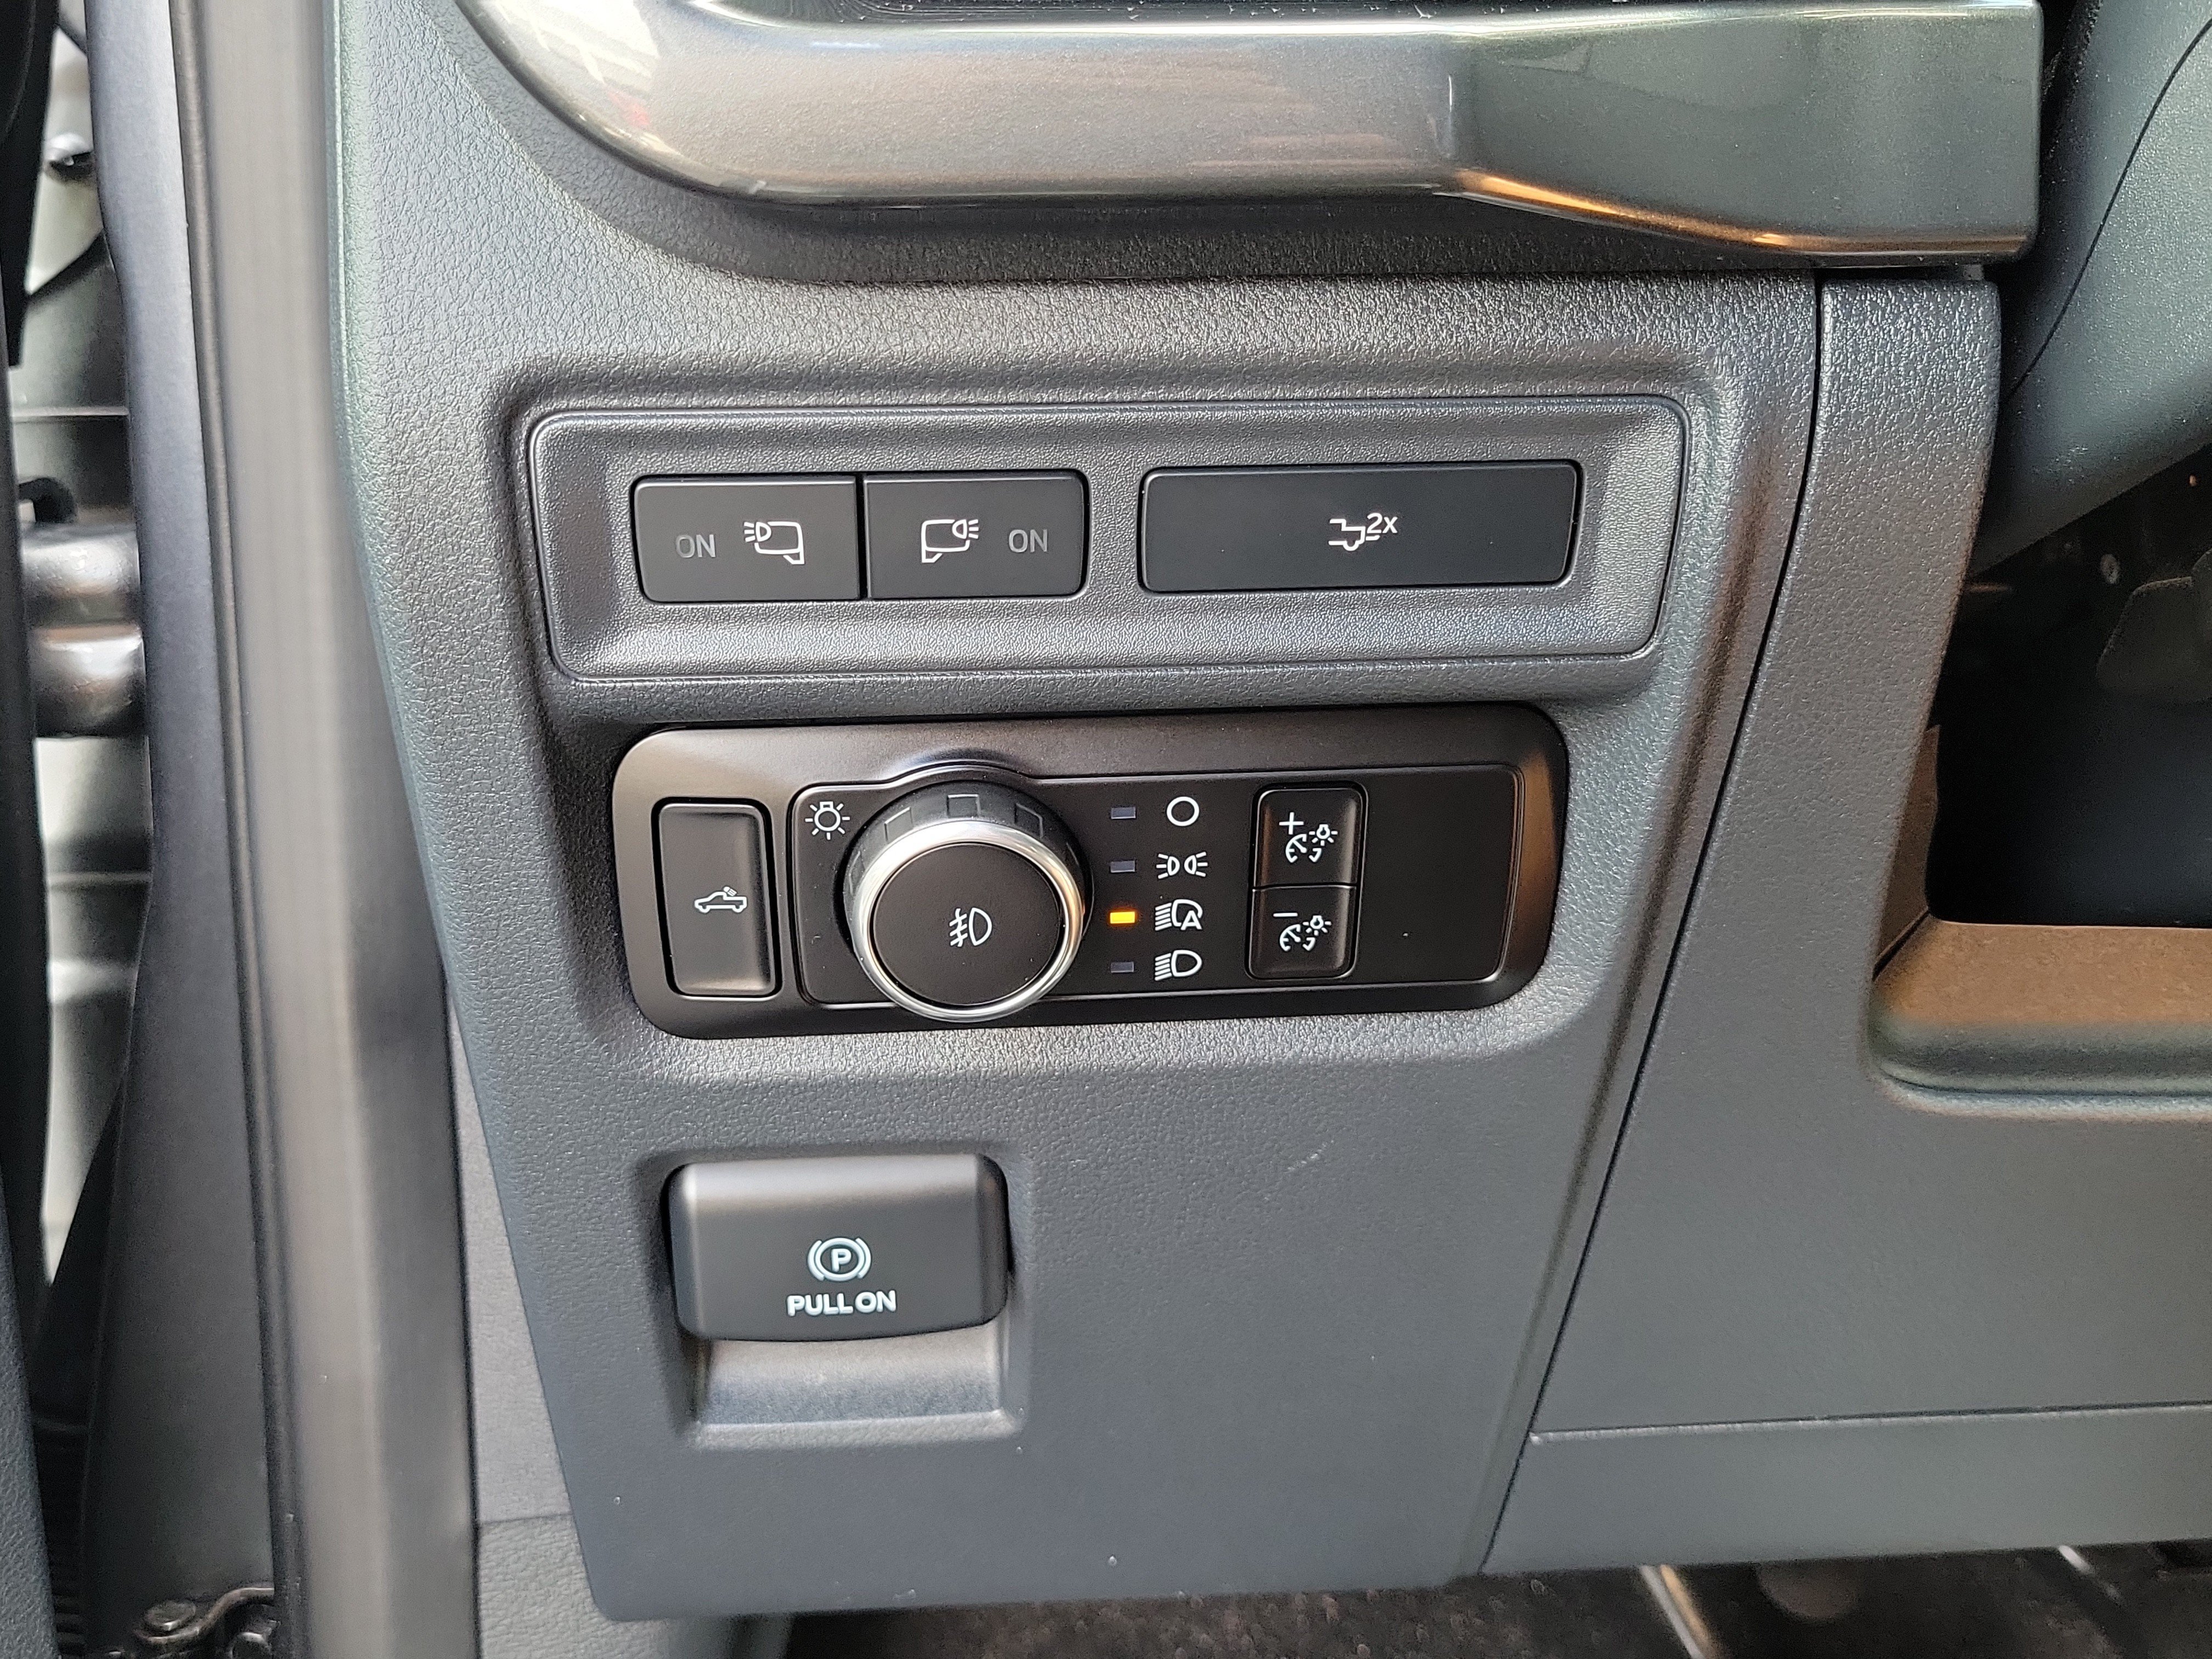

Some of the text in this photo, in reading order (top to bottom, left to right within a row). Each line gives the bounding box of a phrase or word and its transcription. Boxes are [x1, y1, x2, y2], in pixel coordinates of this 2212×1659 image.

[1367, 512, 1398, 534] 2x
[675, 534, 716, 558] ON
[1008, 529, 1047, 553] ON
[831, 1248, 851, 1272] P
[787, 1290, 896, 1317] PULL ON
